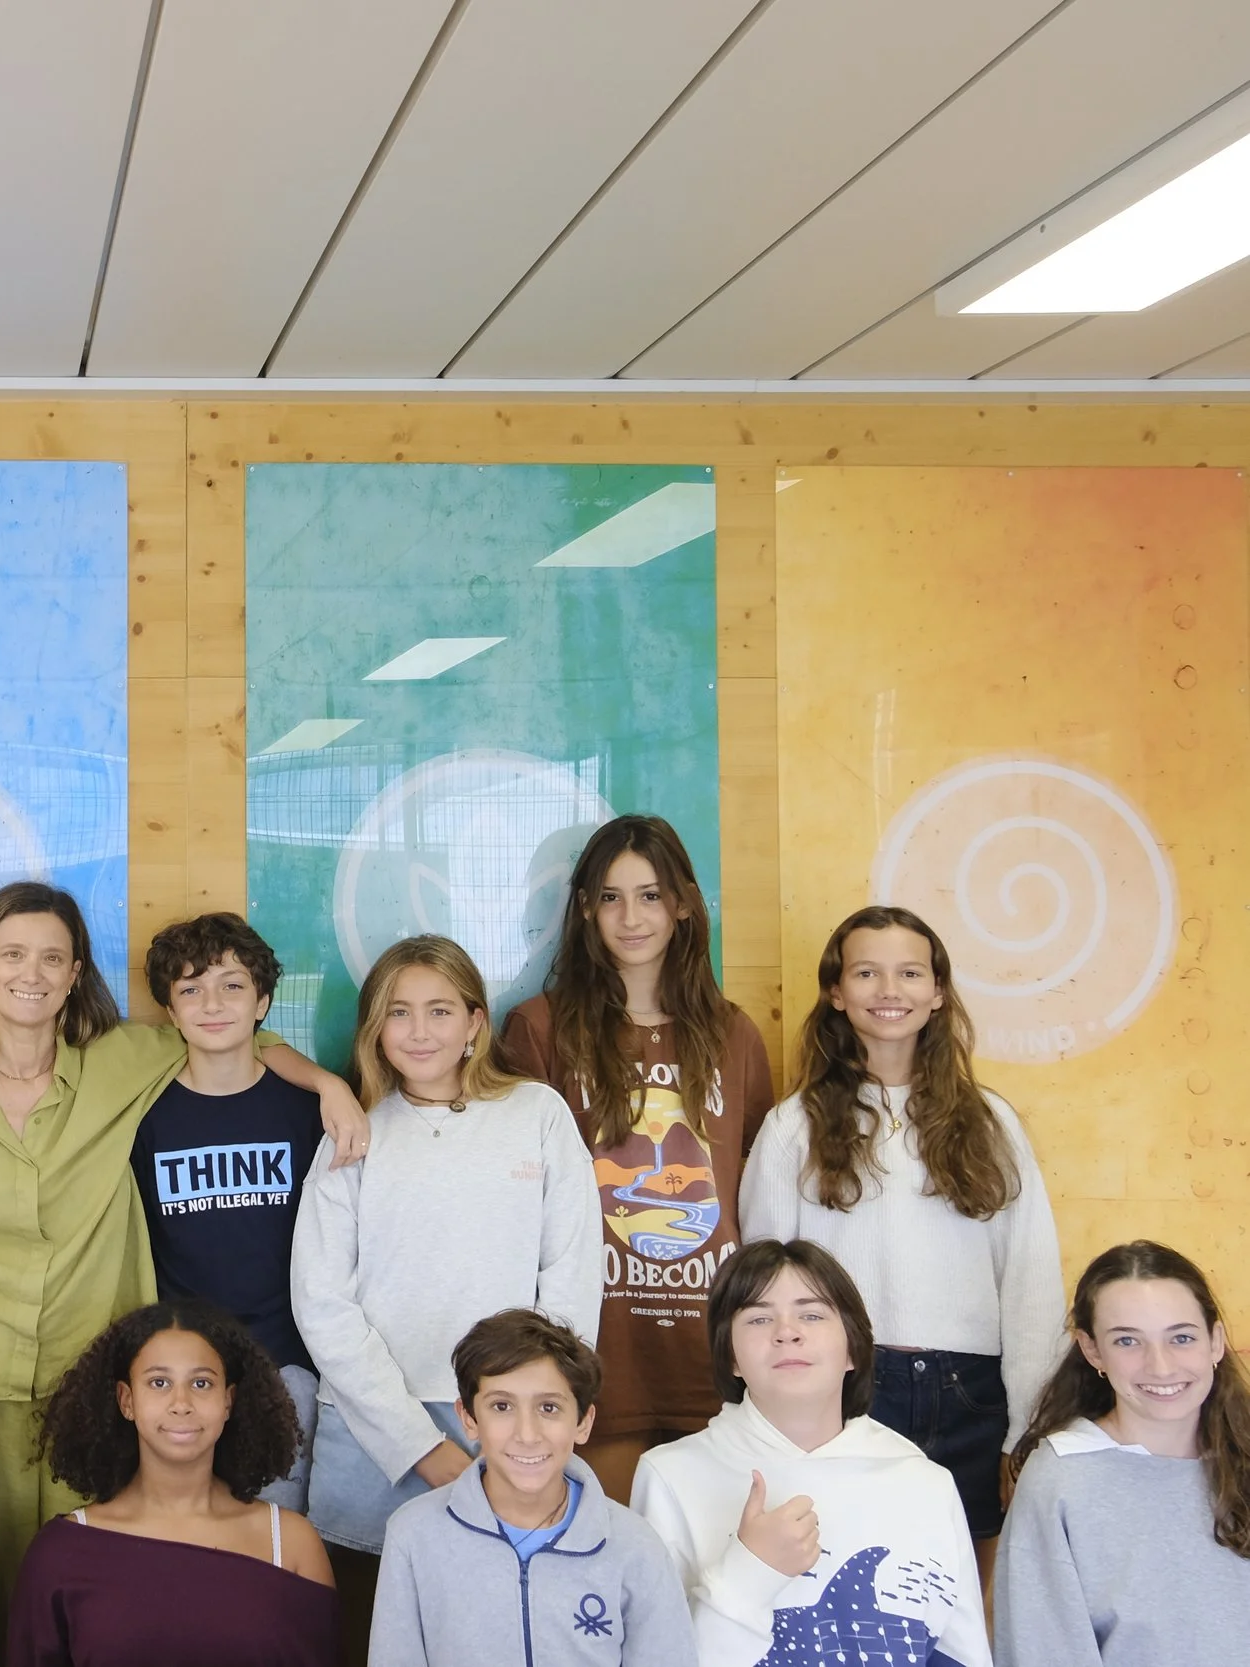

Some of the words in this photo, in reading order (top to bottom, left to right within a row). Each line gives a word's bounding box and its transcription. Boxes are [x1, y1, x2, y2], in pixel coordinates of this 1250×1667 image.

[987, 1025, 1076, 1055] WIND
[160, 1149, 288, 1194] THINK
[161, 1201, 187, 1216] IT'S
[188, 1197, 213, 1213] NOT
[216, 1193, 265, 1209] ILLEGAL
[267, 1192, 289, 1205] YET
[625, 1240, 737, 1289] BECOM
[609, 1289, 625, 1298] river
[626, 1289, 633, 1297] is
[638, 1290, 667, 1300] journey
[668, 1290, 677, 1299] to
[678, 1291, 709, 1301] somethi
[630, 1306, 672, 1317] GREENISH
[683, 1310, 701, 1318] 1992
